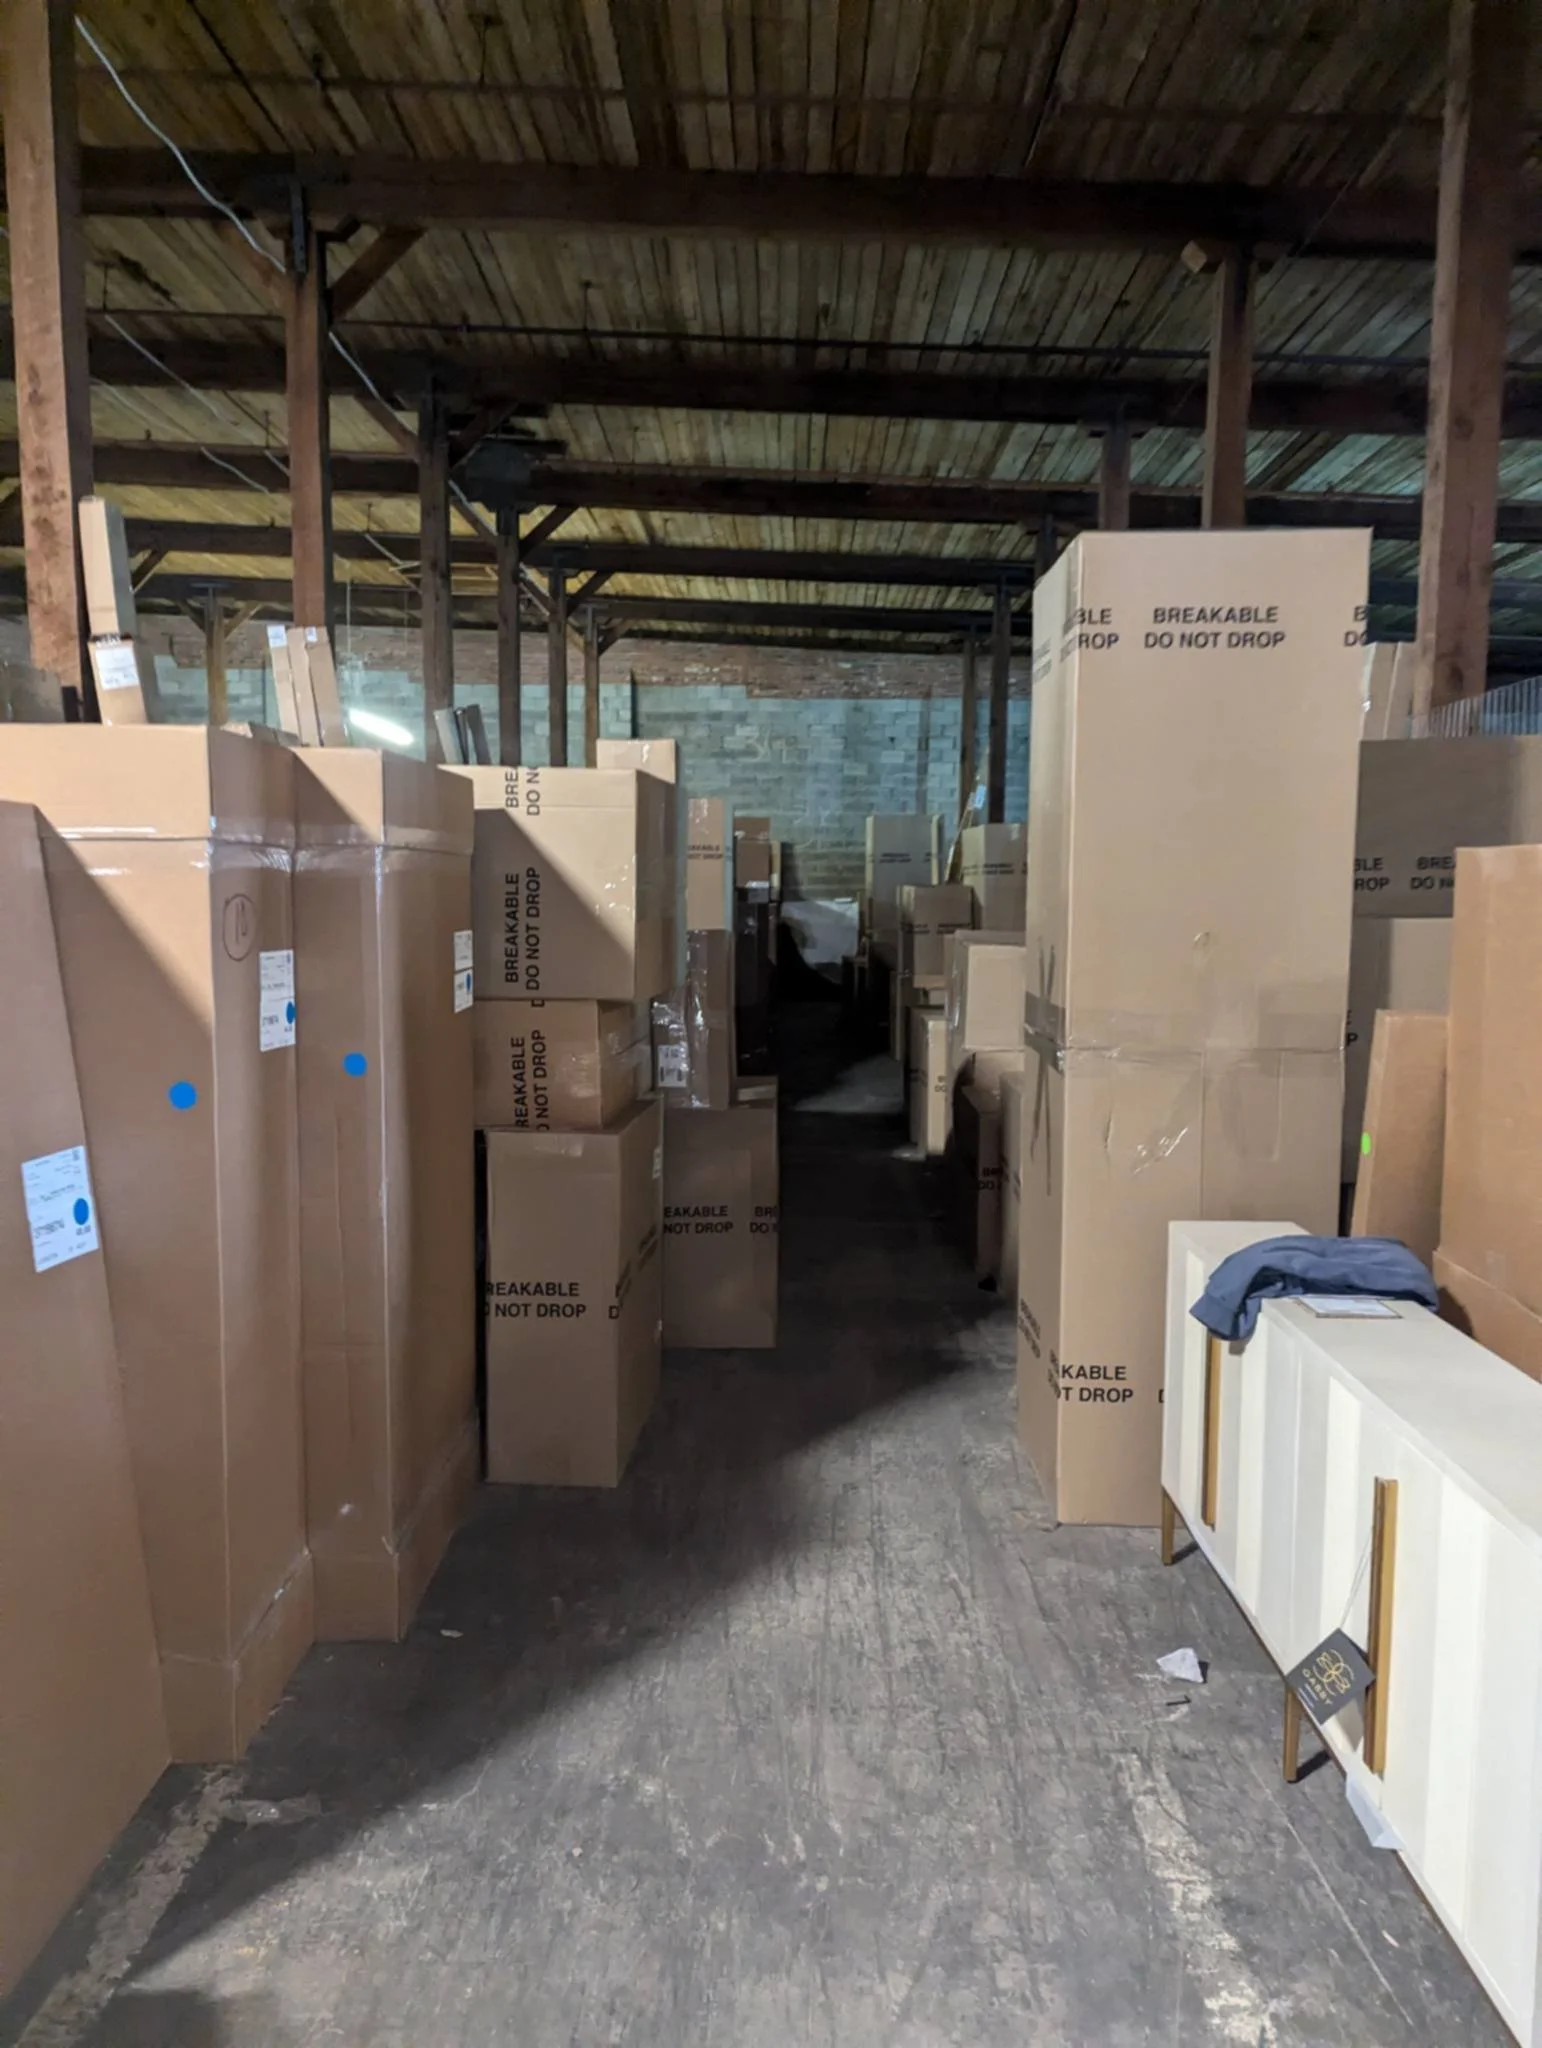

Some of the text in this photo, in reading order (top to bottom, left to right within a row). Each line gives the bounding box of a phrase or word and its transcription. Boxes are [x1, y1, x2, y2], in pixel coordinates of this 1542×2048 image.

[1153, 606, 1278, 624] BREAKABLE
[1144, 631, 1286, 649] DO NOT DROP
[526, 789, 541, 816] DO
[526, 867, 540, 918] DROP
[1410, 876, 1435, 890] DO
[504, 873, 520, 983] BREAKABLE
[525, 923, 540, 960] NOT
[525, 964, 540, 991] DO
[531, 1029, 548, 1079] DROP
[534, 1083, 549, 1119] NOT
[696, 1222, 734, 1234] DROP
[749, 1222, 770, 1235] DO
[495, 1303, 531, 1318] NOT
[537, 1303, 587, 1318] DROP
[1079, 1387, 1134, 1404] DROP
